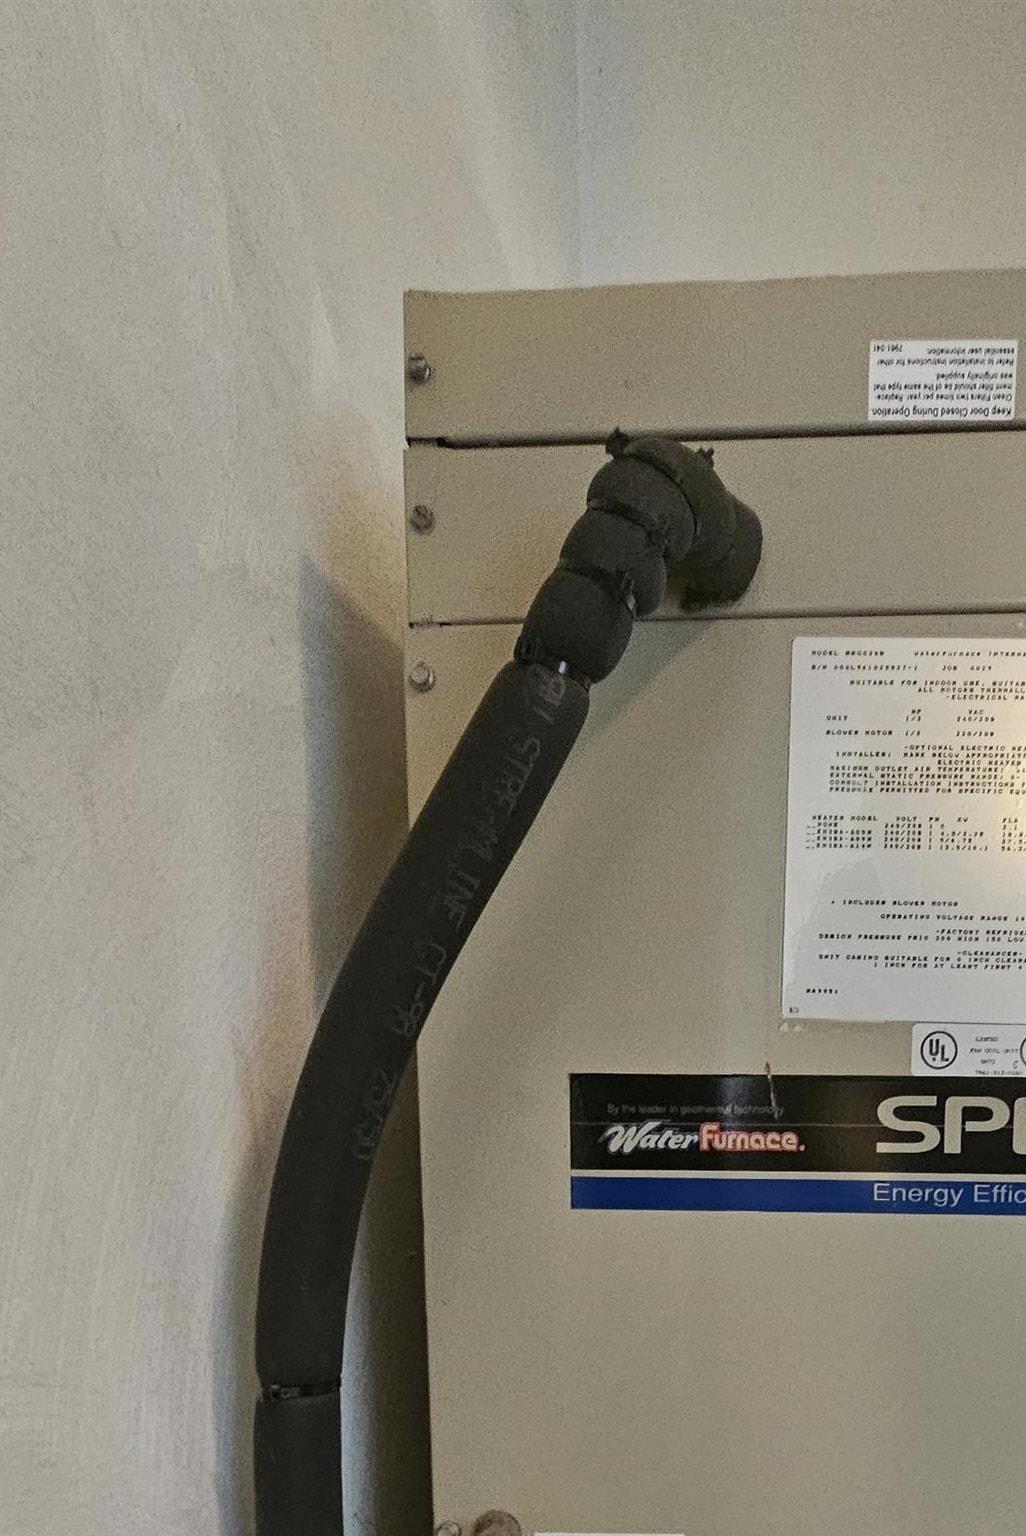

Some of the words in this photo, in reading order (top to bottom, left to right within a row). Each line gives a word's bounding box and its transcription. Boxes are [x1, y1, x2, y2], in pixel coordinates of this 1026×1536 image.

[896, 359, 905, 367] for
[873, 406, 910, 417] Operation
[913, 406, 938, 417] During
[941, 407, 968, 417] Closed
[971, 407, 989, 417] Door
[992, 405, 1012, 416] Keep
[607, 1104, 619, 1114] By
[622, 1104, 635, 1113] the
[638, 1104, 666, 1113] leader
[670, 1105, 678, 1113] in
[873, 1183, 964, 1207] Energy
